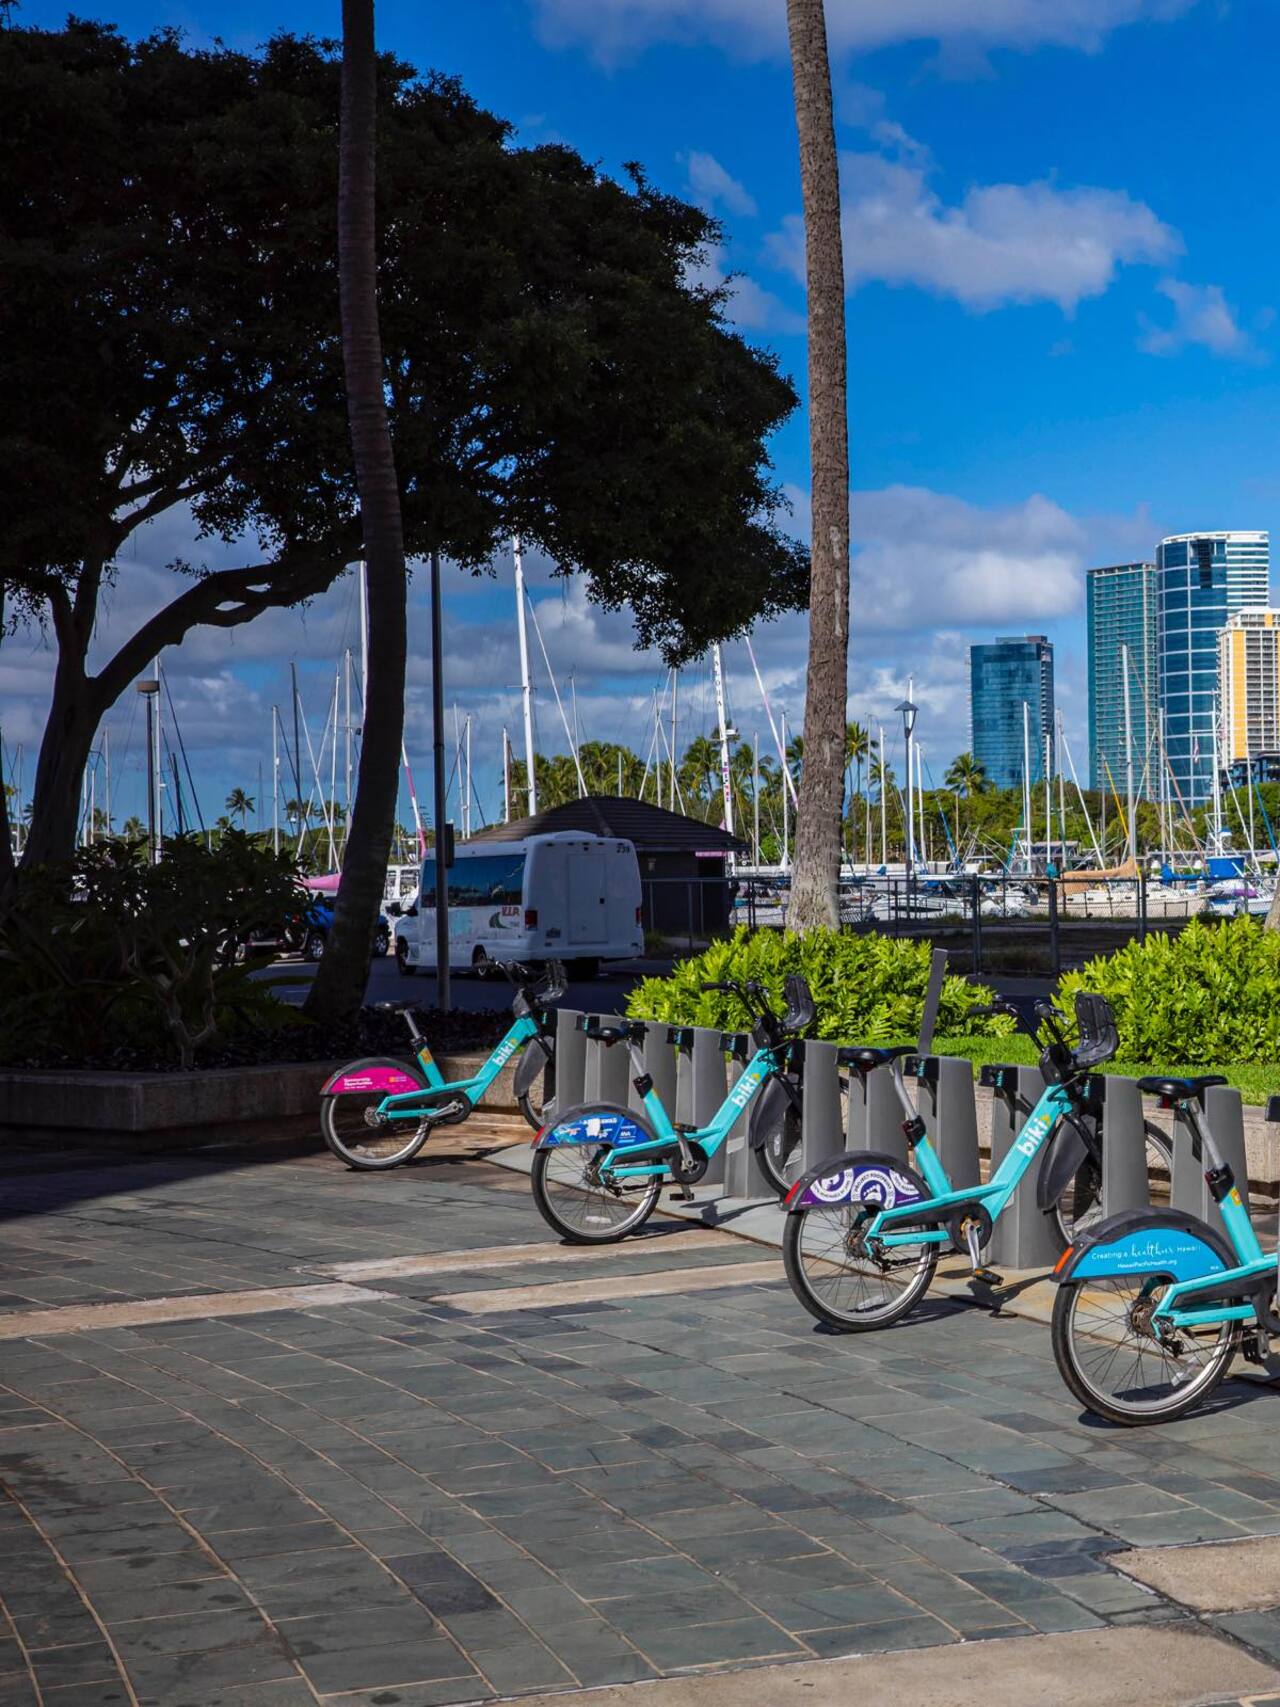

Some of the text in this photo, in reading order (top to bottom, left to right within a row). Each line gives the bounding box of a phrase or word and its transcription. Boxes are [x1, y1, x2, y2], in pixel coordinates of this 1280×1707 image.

[492, 1041, 516, 1067] biki
[731, 1076, 758, 1109] biki
[1017, 1118, 1047, 1157] biki
[1091, 1252, 1122, 1261] Creating
